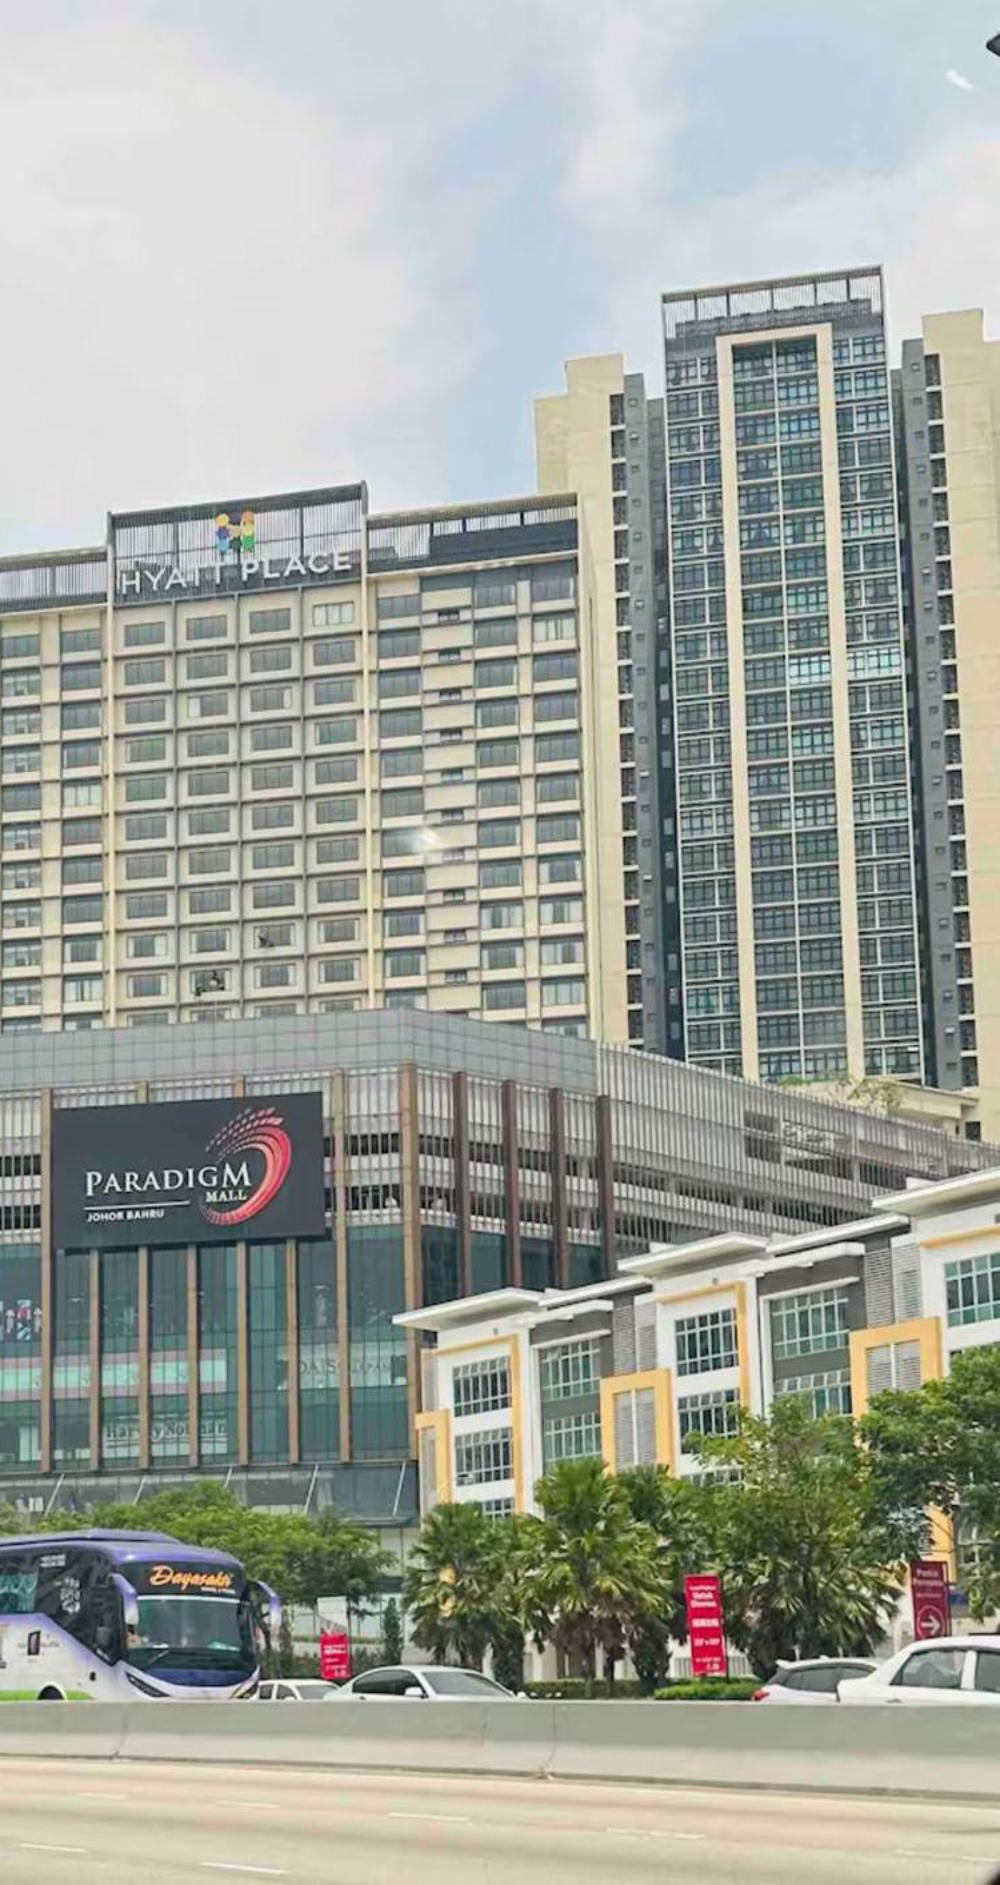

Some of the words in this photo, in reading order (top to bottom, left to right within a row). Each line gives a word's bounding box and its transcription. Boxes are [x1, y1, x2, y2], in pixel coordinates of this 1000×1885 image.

[120, 561, 224, 595] HYATT
[241, 552, 352, 582] PLACE
[85, 1161, 251, 1197] PARADIGM
[206, 1189, 248, 1203] MALL
[87, 1211, 125, 1223] JOHOR
[127, 1208, 165, 1220] BAHRU
